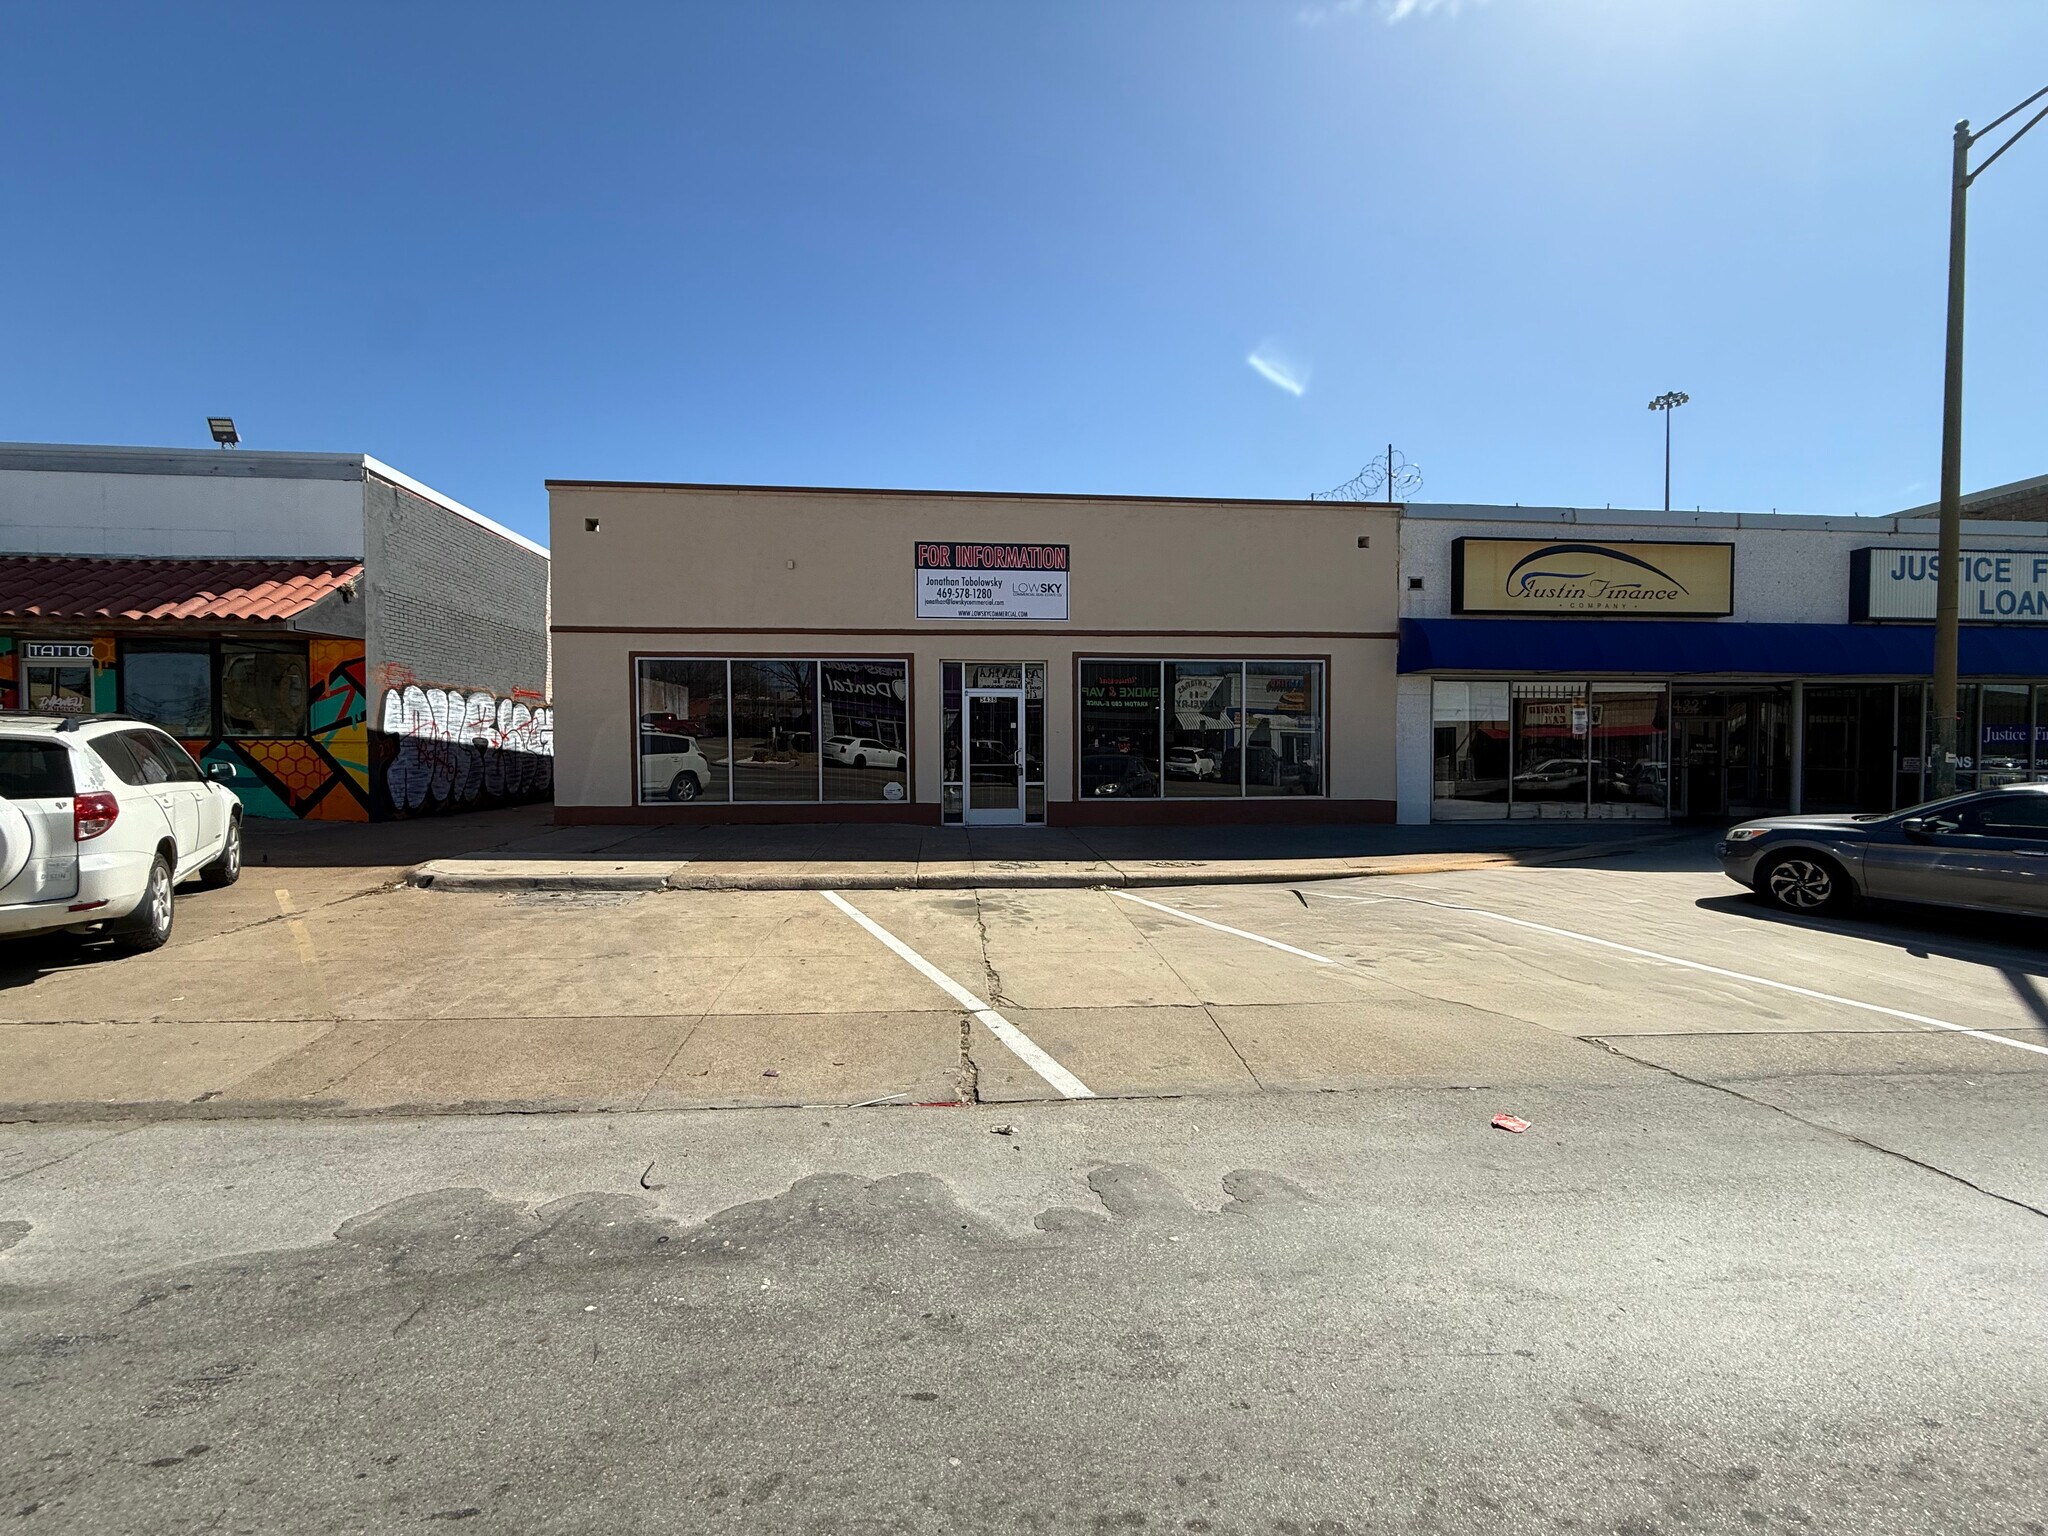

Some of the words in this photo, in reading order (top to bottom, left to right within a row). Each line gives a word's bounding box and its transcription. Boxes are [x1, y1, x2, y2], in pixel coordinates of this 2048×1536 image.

[918, 544, 951, 567] FOR
[955, 545, 1067, 569] INFORMATION
[1891, 556, 2012, 583] JUSICE
[926, 576, 960, 587] Jonathan
[962, 577, 1003, 589] Tobolowsky
[1012, 583, 1062, 593] LOWSKY
[936, 588, 992, 599] 469-578-1280
[1588, 579, 1678, 600] Finance
[1569, 602, 1628, 610] COMPANY
[958, 610, 1029, 618] WWW.LOWSKYCOMMERCIAL.COM
[1983, 726, 2027, 743] Justice
[2034, 726, 2048, 741] Fi
